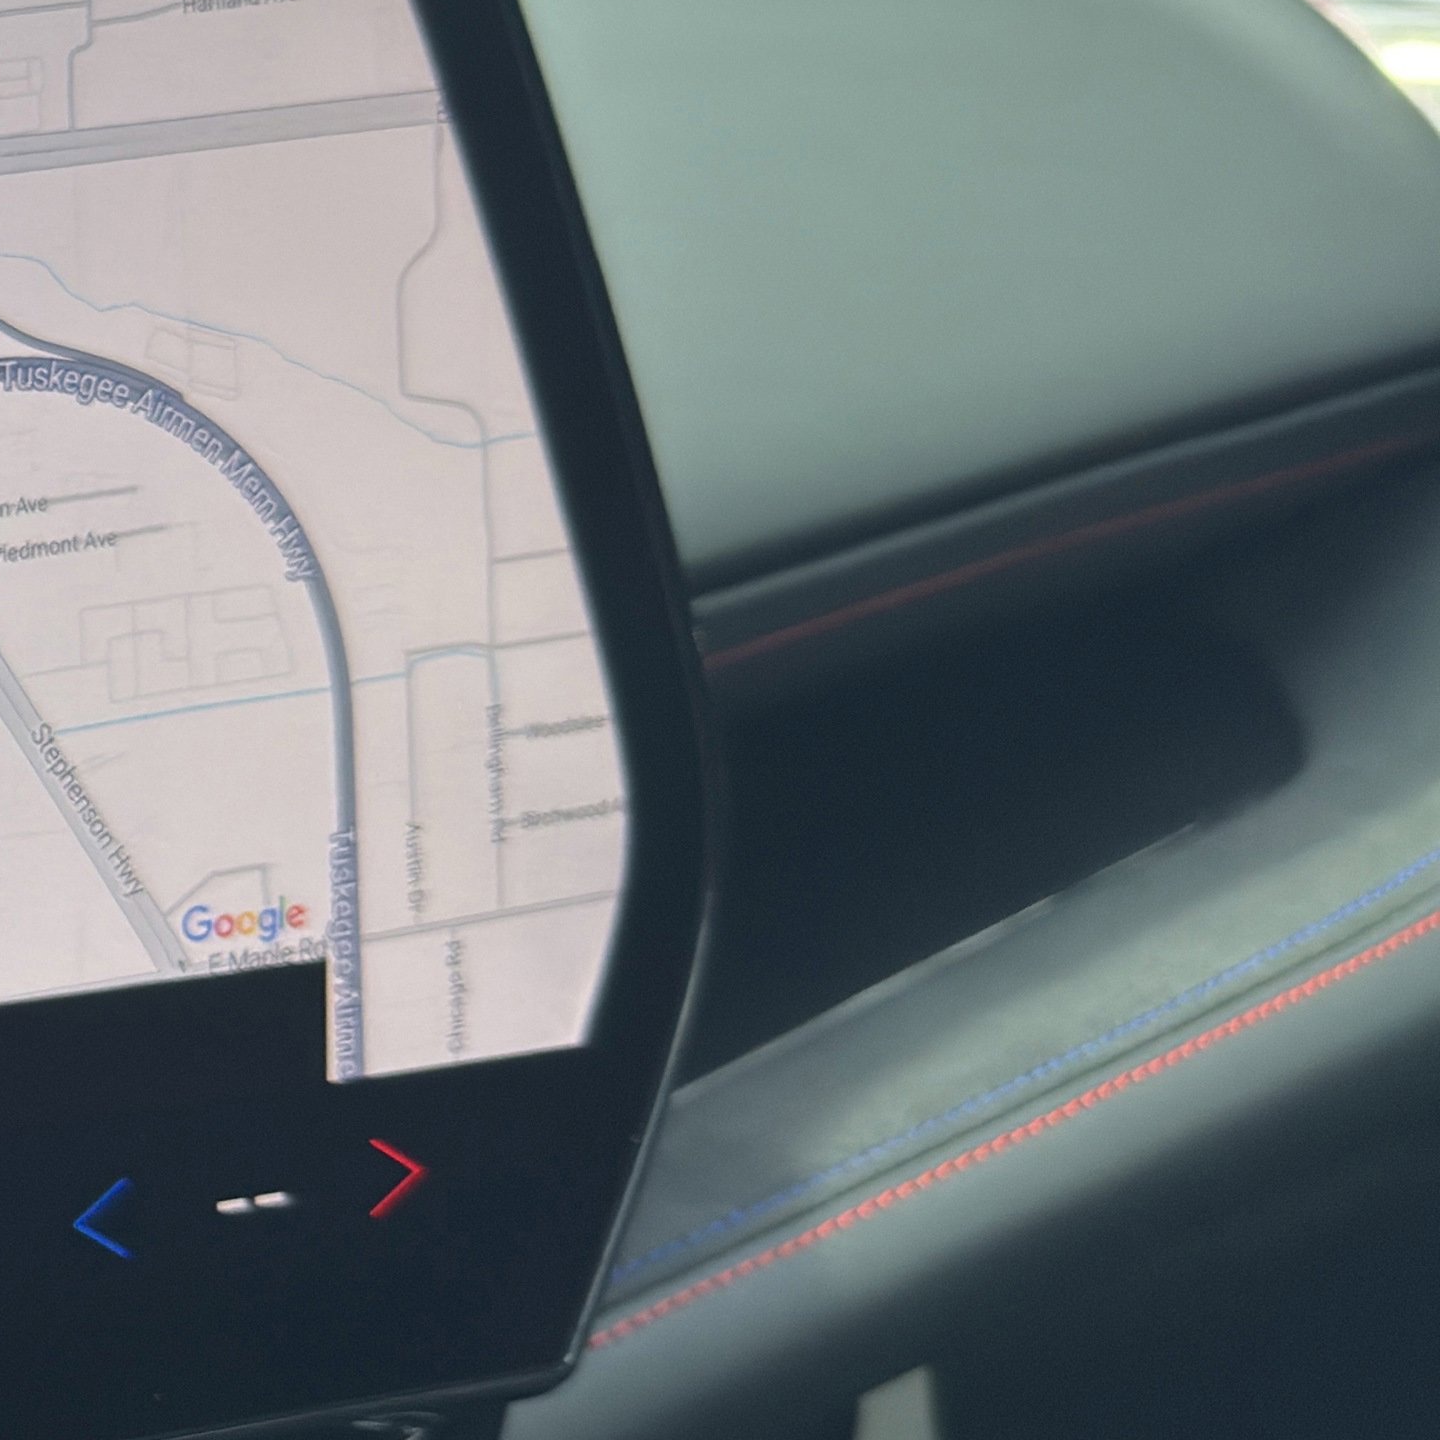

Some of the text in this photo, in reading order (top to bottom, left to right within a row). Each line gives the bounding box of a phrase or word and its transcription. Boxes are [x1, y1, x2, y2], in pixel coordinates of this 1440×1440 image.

[0, 360, 318, 584] Tuskegee Airmen Mem Hwy
[12, 495, 49, 515] Ave
[80, 529, 119, 550] Ave
[30, 722, 146, 898] Stephenson Hwy
[181, 899, 307, 944] Google
